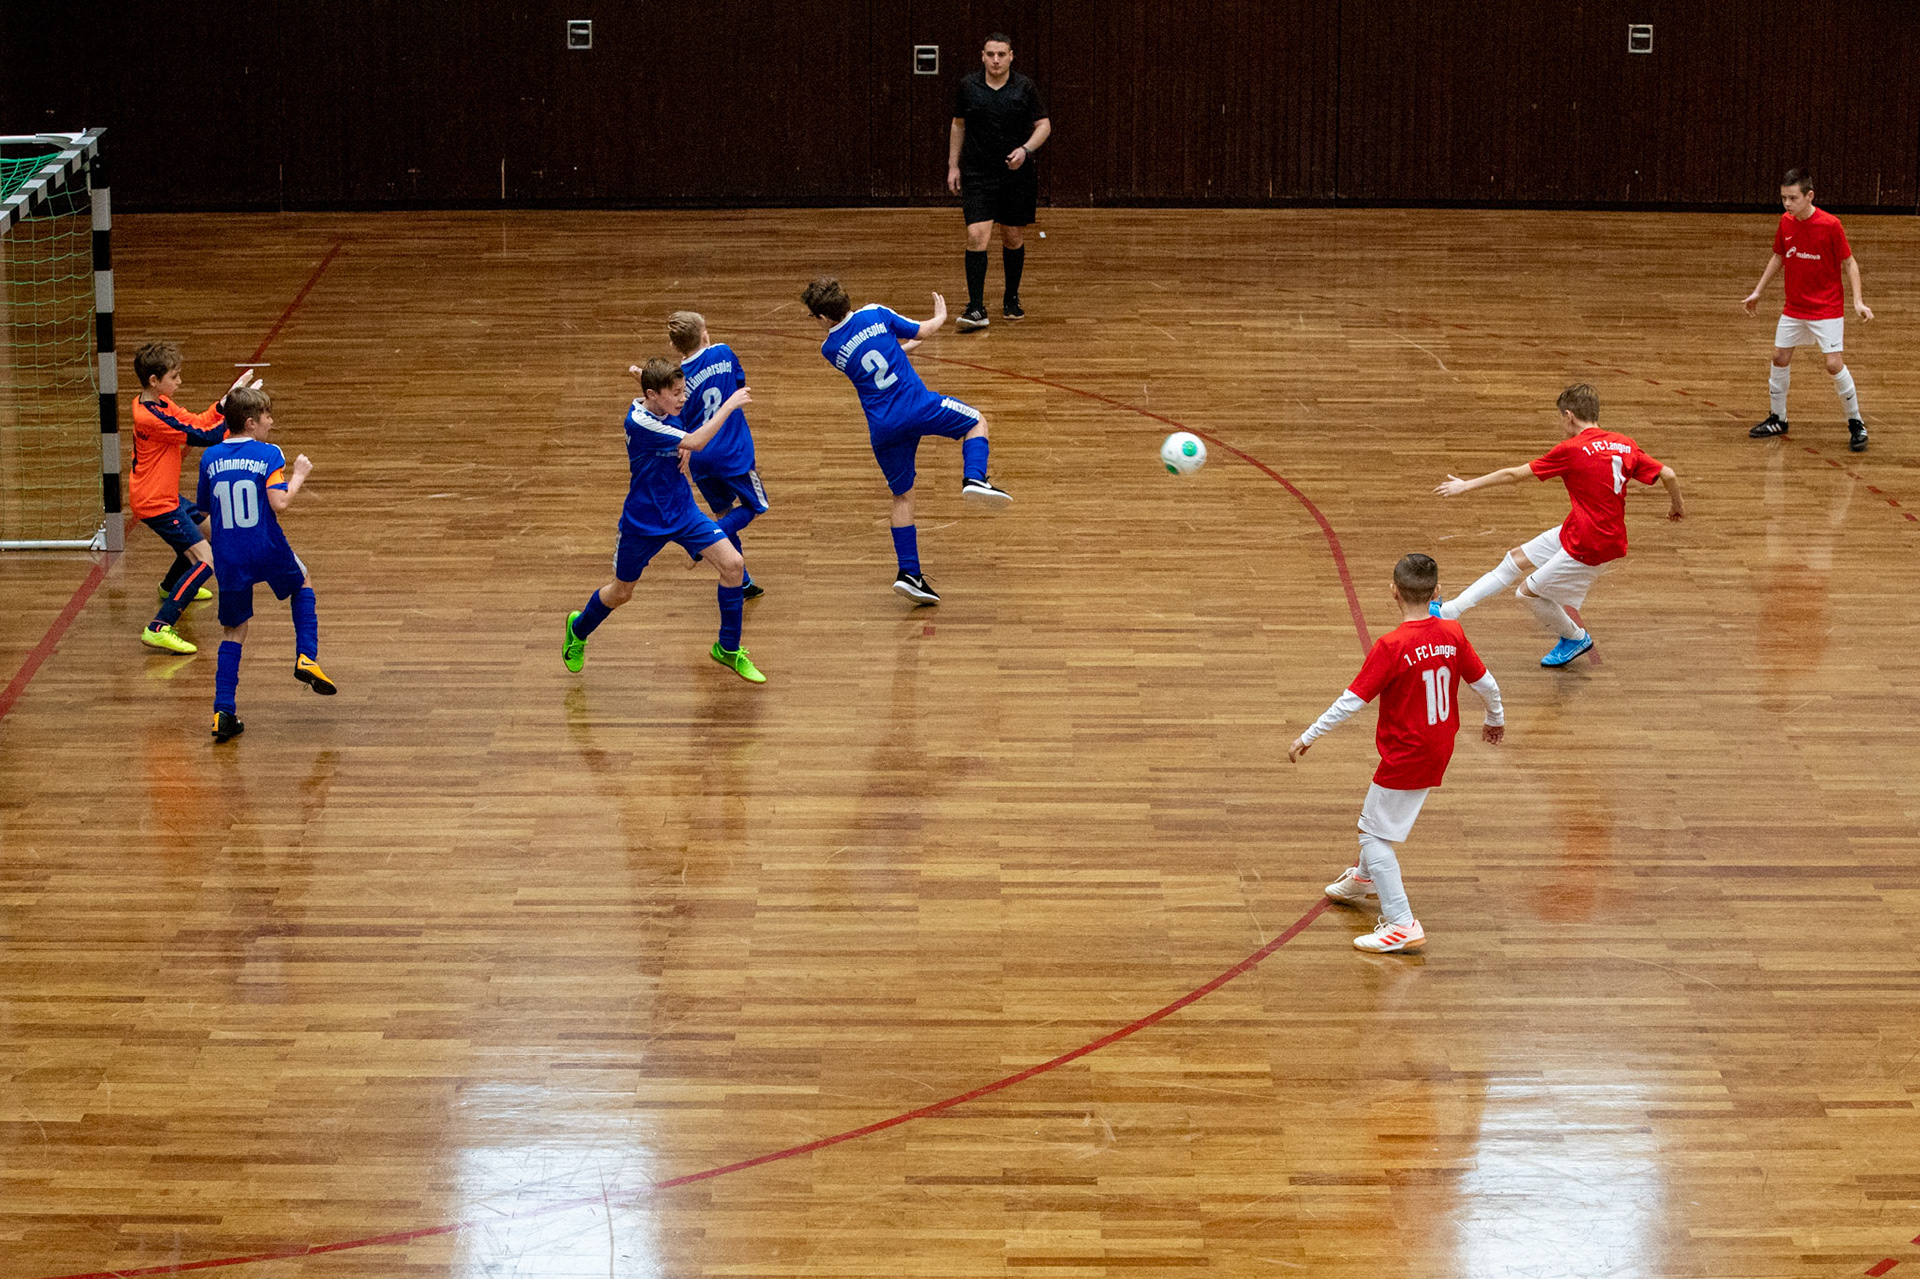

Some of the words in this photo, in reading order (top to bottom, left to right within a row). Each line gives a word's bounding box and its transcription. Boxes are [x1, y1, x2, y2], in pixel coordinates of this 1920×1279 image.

[838, 322, 888, 358] Lämmerspiel
[861, 349, 899, 391] 2
[1582, 445, 1595, 456] 1.
[1591, 440, 1605, 452] FC
[1603, 440, 1631, 454] Langen
[215, 457, 269, 476] Lämmerspiel
[213, 479, 259, 529] 10
[1403, 653, 1417, 666] 1.
[1415, 646, 1429, 661] FC
[1422, 665, 1451, 726] 10
